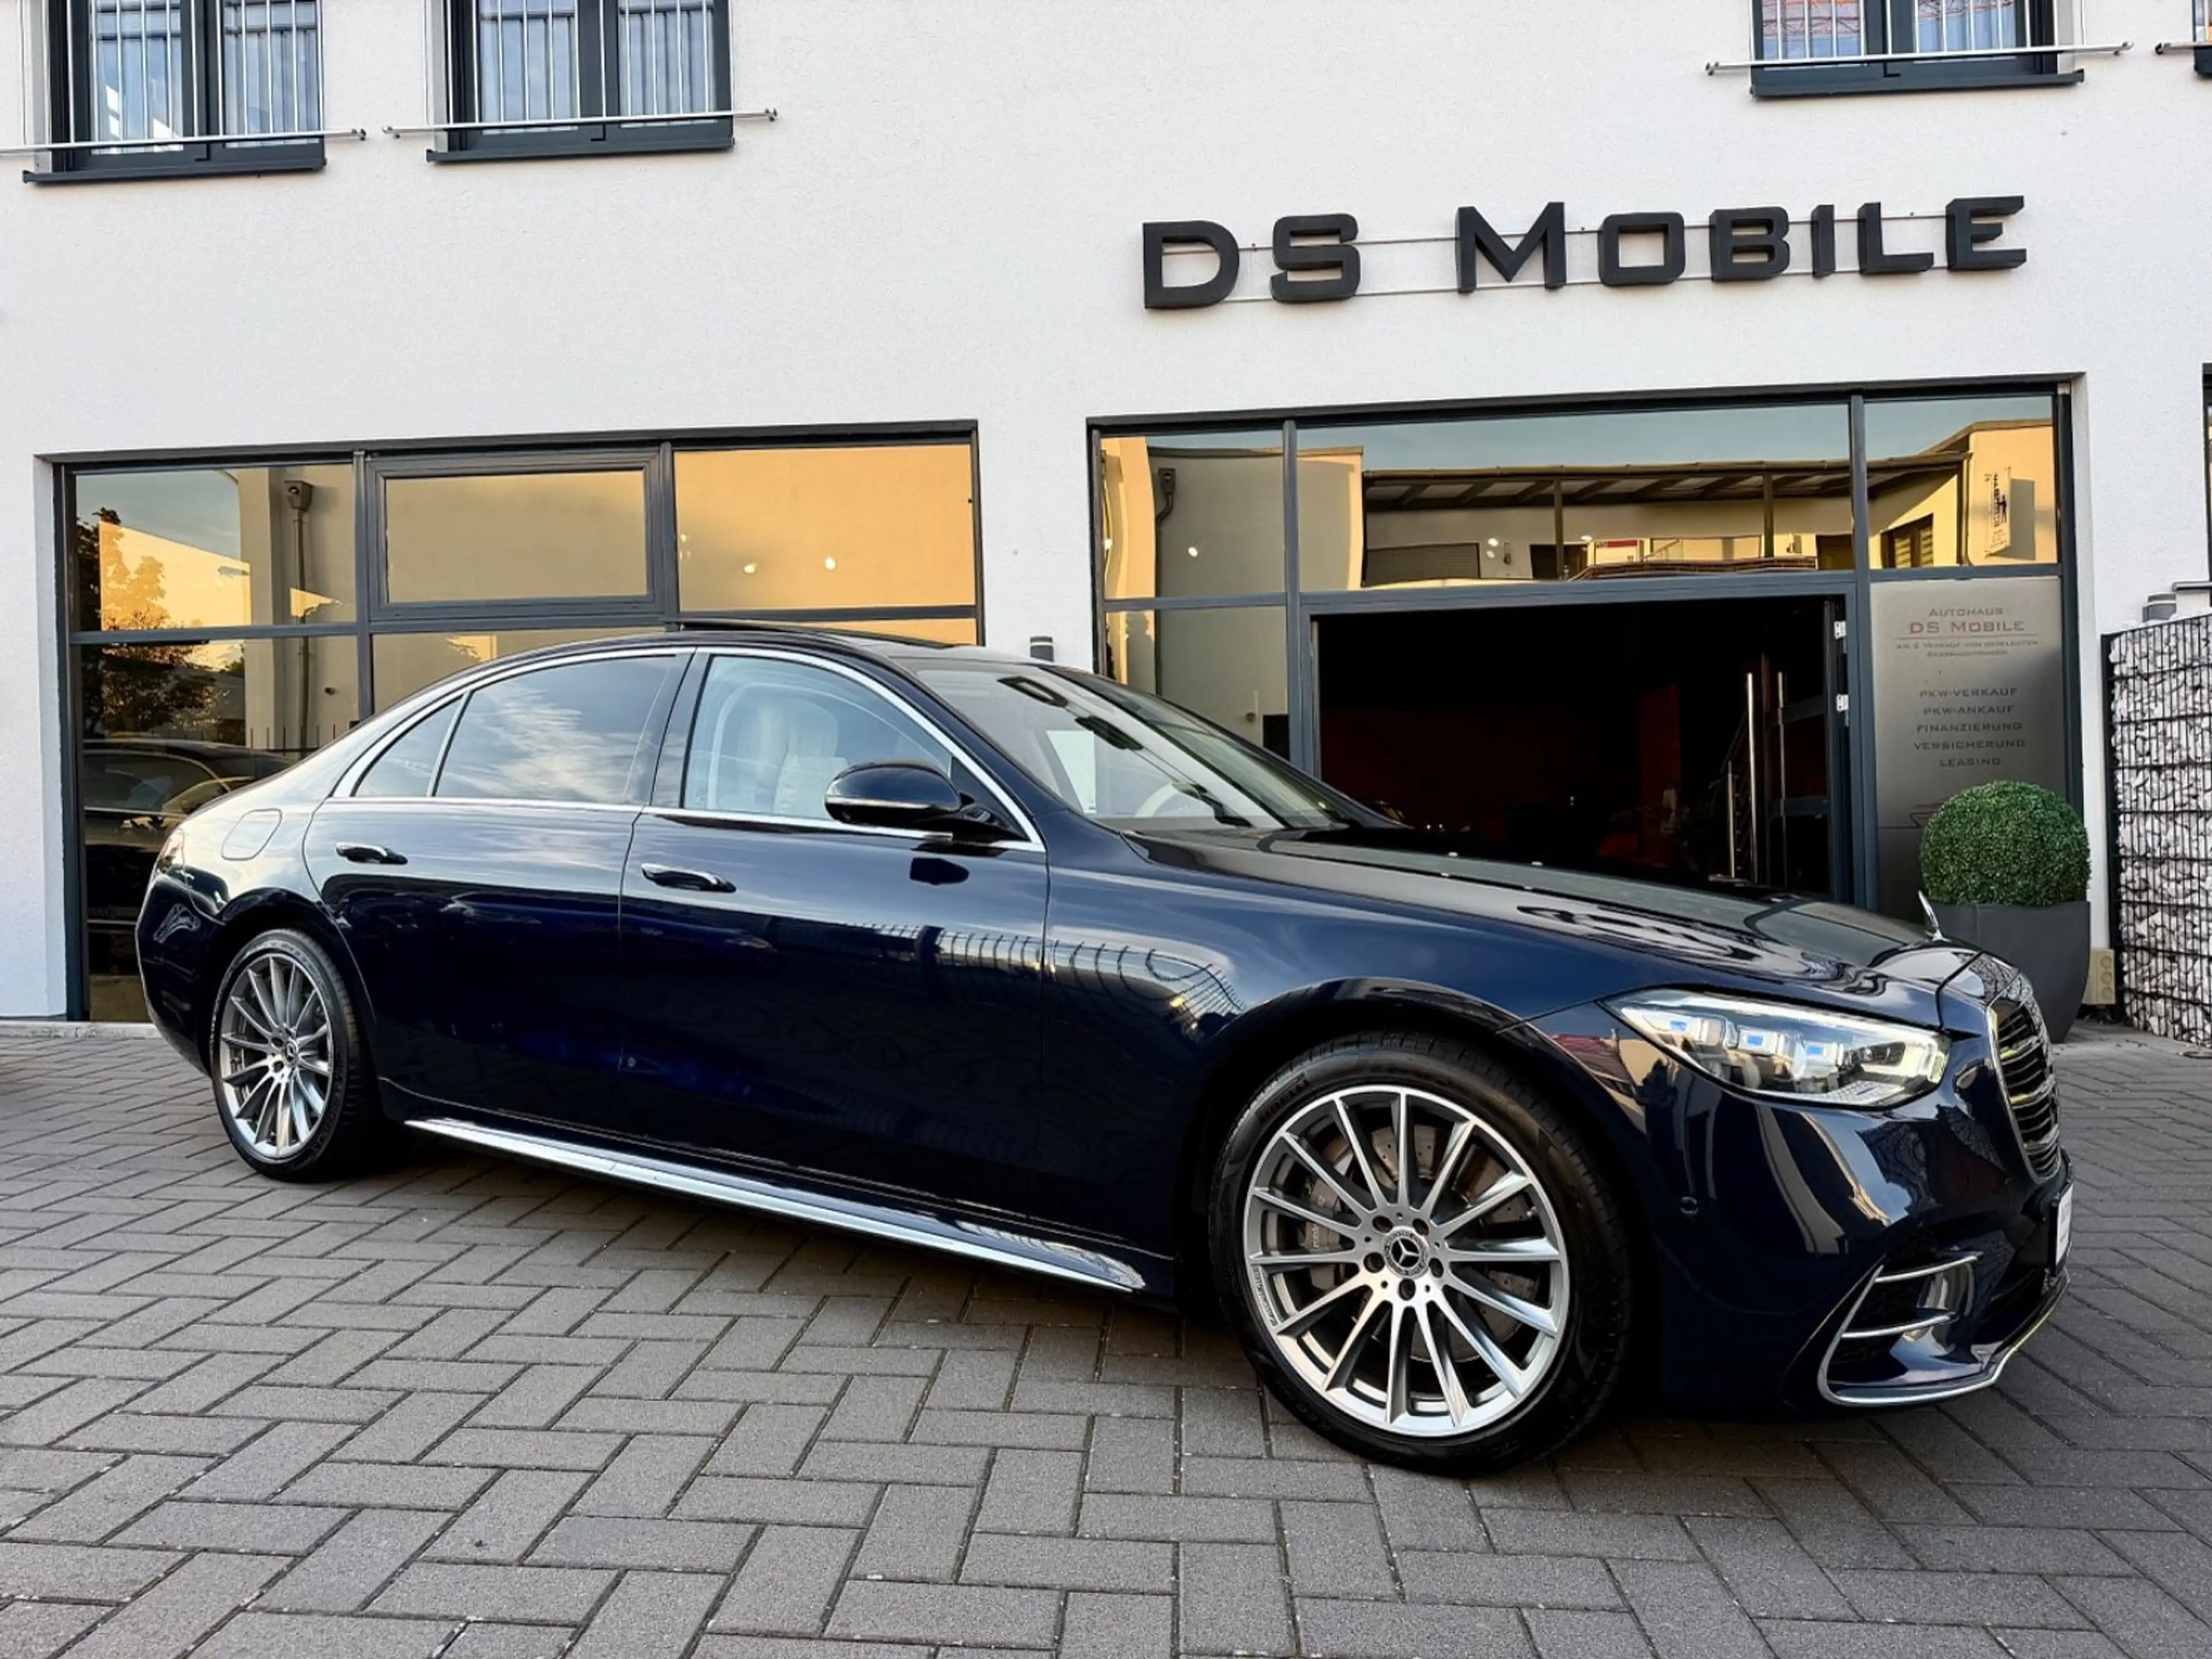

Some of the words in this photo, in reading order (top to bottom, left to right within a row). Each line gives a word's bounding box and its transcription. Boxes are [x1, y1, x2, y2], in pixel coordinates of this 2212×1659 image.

[1143, 214, 1357, 311] DS
[1455, 196, 2027, 295] MOBILE
[1929, 608, 2003, 618] AUTOHAUS
[1910, 622, 1940, 634] DS
[1951, 620, 2025, 632] MOBILE
[1919, 687, 2017, 698] PKW-VERKAUF
[1924, 706, 2014, 715] PKW-ANKAUF
[1916, 722, 2022, 733] FINANZIERUNG
[1913, 740, 2025, 751] VERSICHERUNG
[1939, 757, 2001, 768] LEASING
